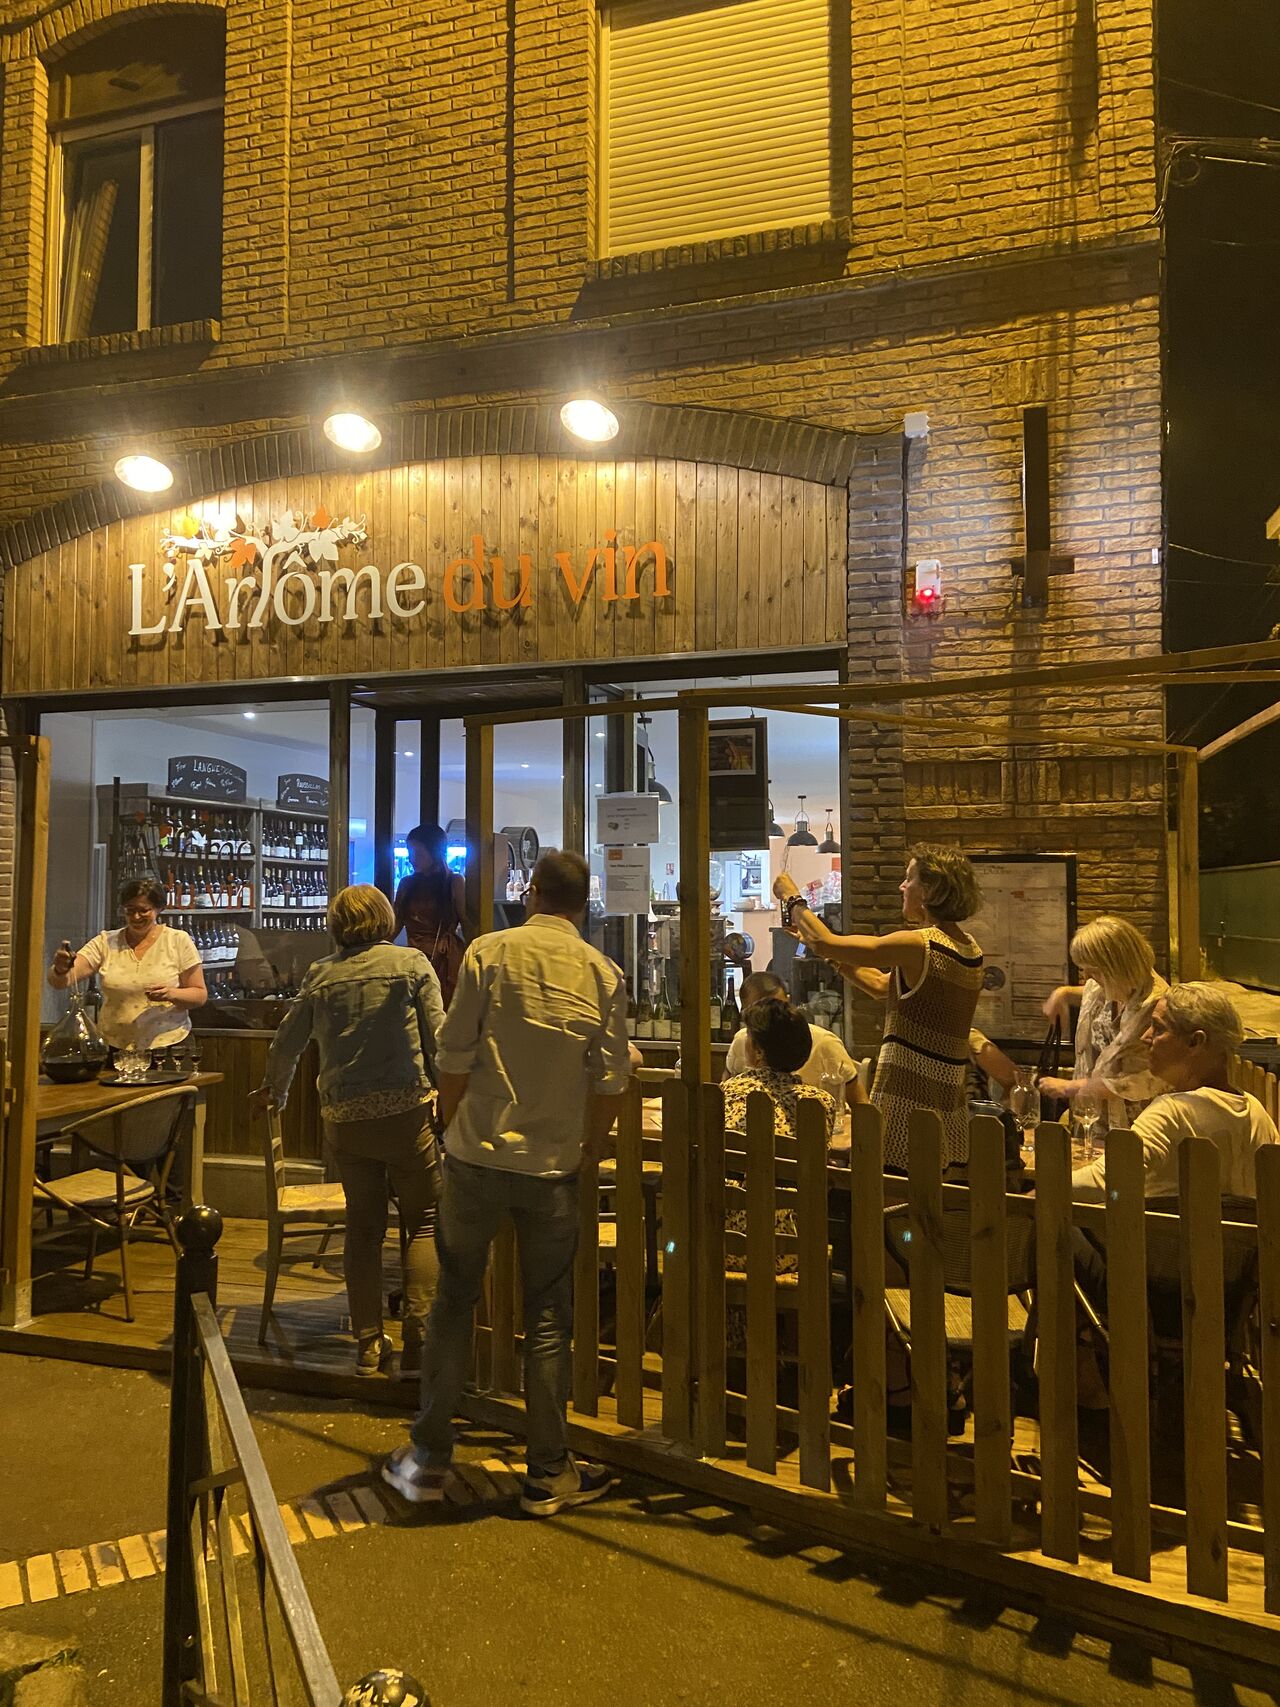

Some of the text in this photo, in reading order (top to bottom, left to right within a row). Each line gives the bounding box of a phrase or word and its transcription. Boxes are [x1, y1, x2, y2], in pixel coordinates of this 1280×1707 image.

[128, 528, 671, 636] L'Arôme du vin
